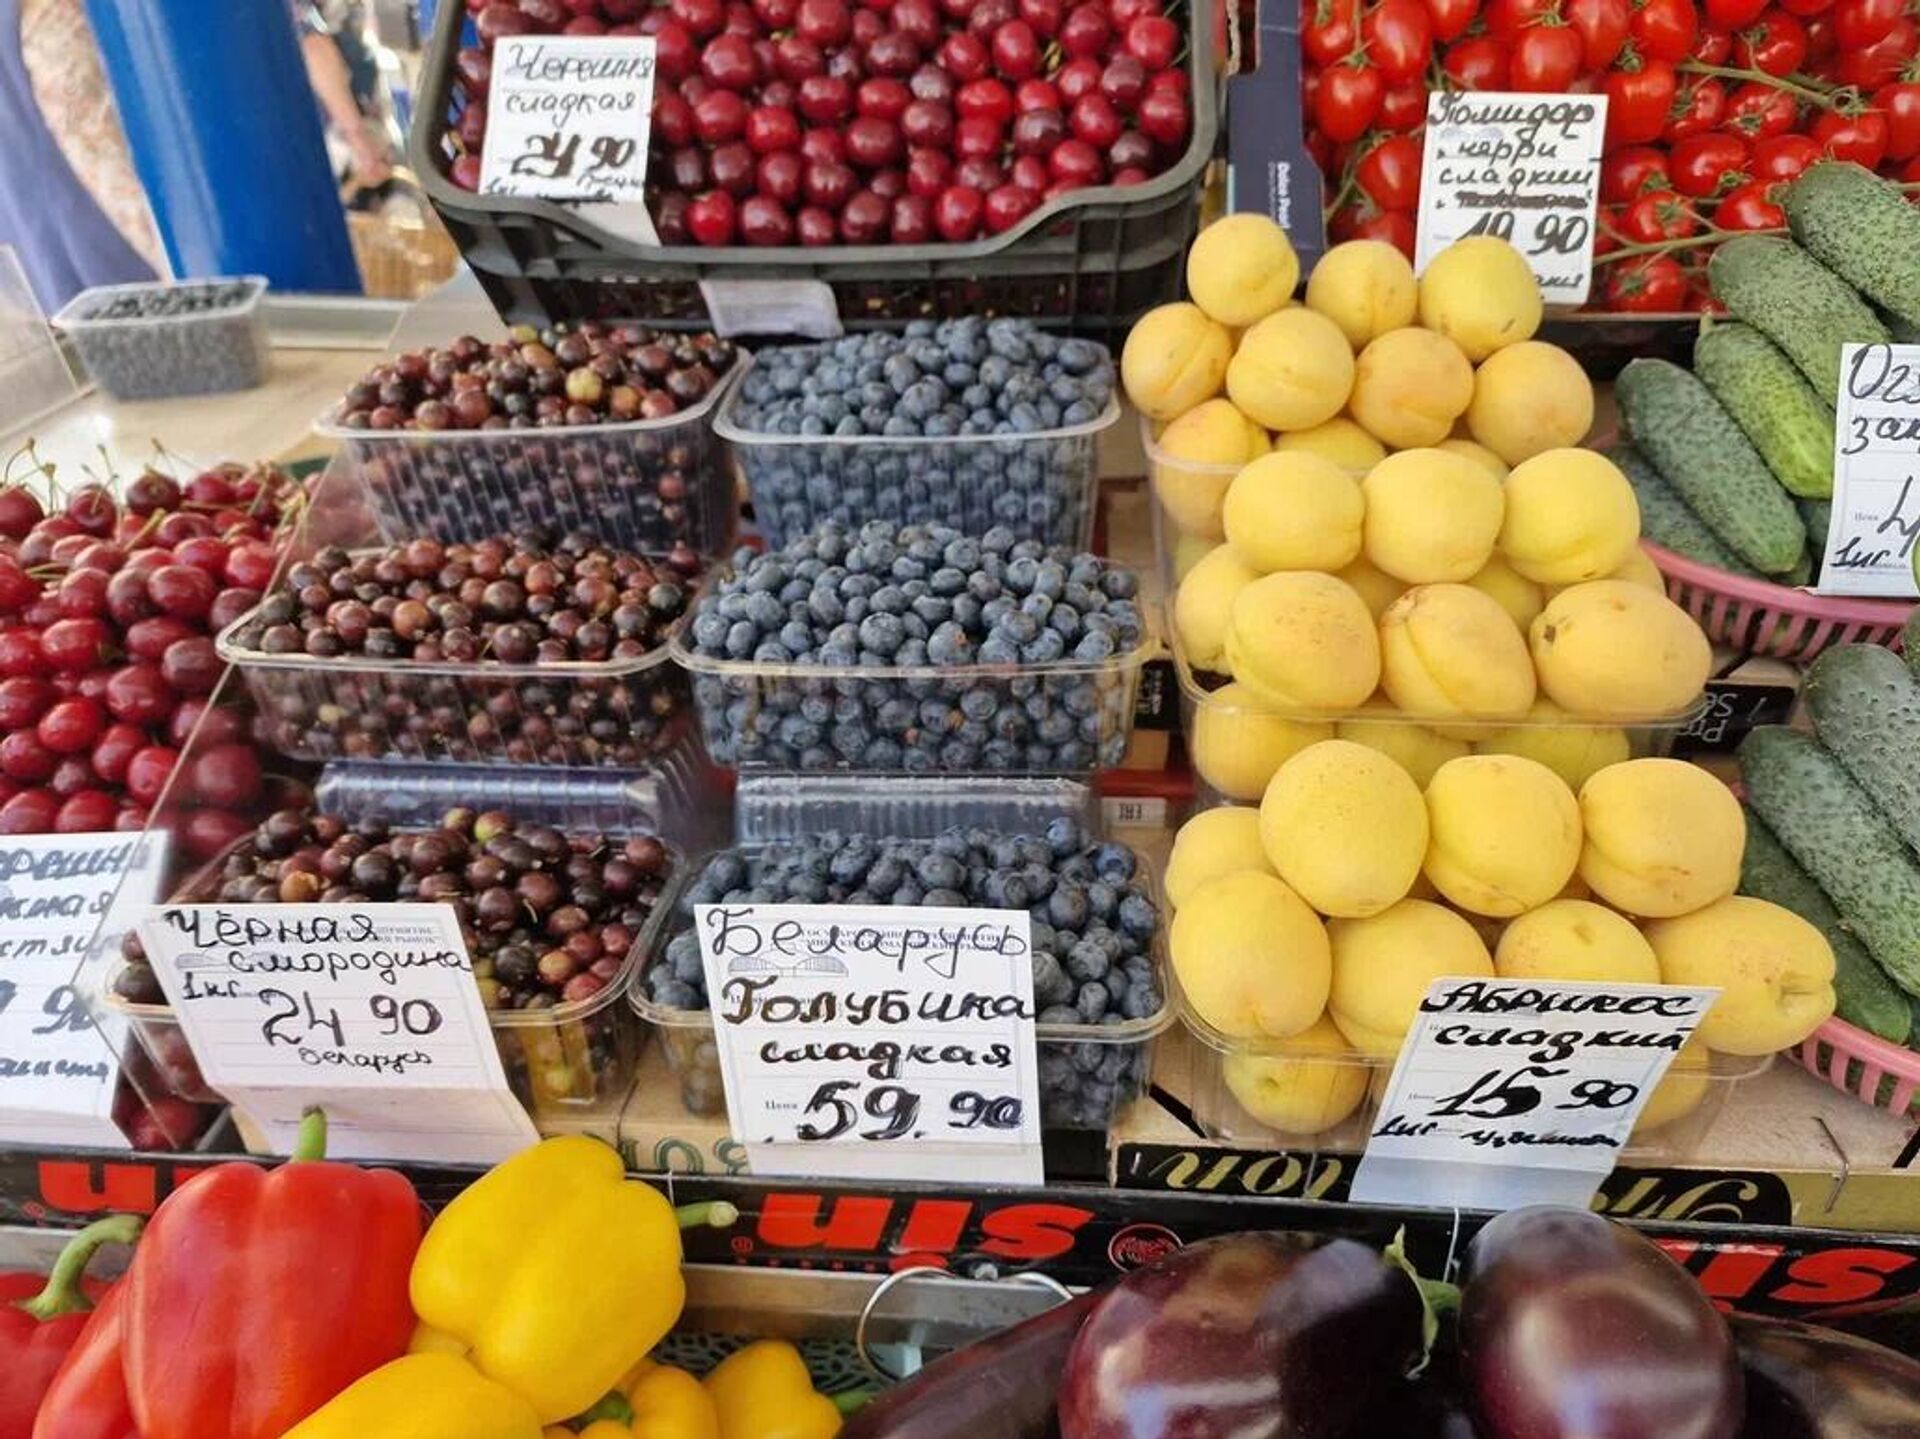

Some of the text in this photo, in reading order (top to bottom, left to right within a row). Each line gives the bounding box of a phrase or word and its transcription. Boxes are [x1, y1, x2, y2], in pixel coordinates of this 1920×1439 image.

[506, 93, 636, 129] сладкая
[586, 136, 637, 172] 90
[1526, 213, 1590, 255] 90
[164, 908, 379, 949] Чёрная
[706, 907, 1028, 980] Беларусь
[259, 988, 443, 1048] 24 90
[760, 1041, 1012, 1080] сладкая
[947, 1090, 1024, 1129] 90
[1555, 1079, 1640, 1110] 90
